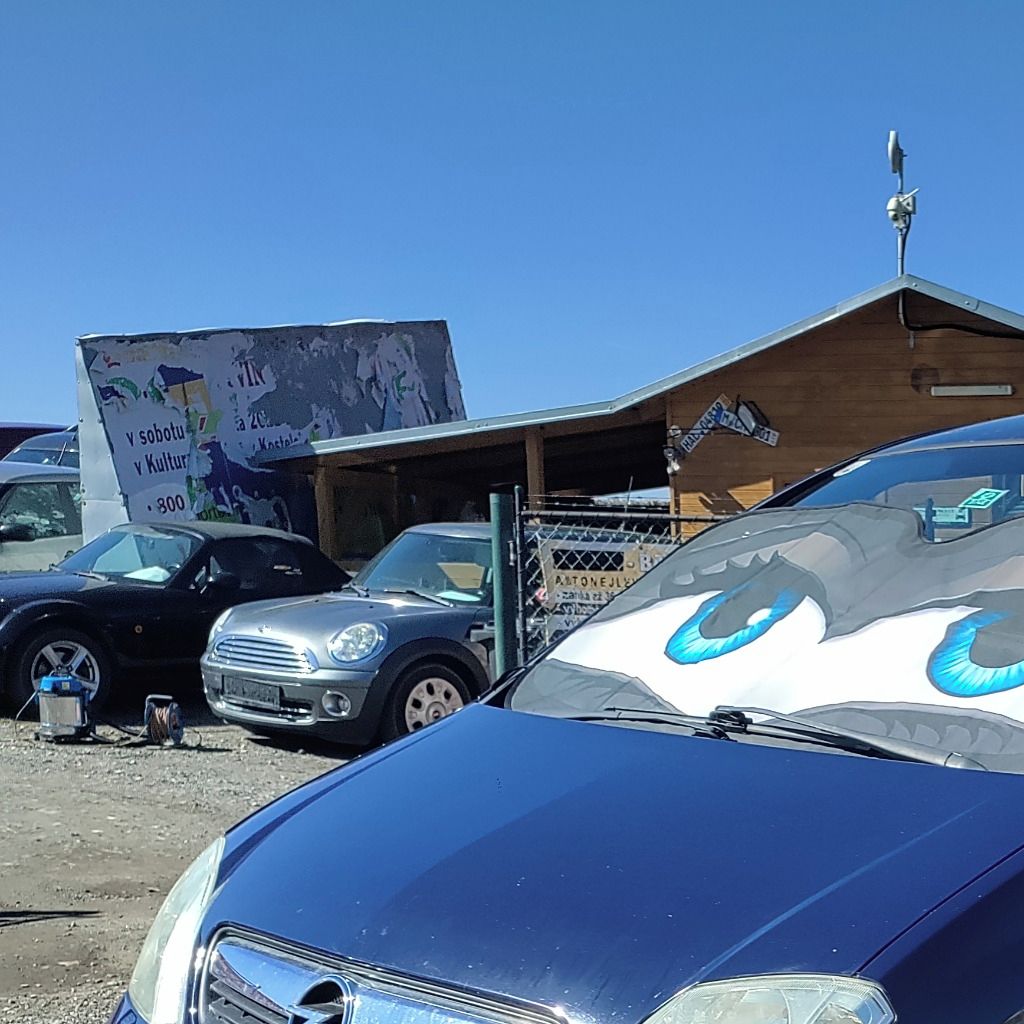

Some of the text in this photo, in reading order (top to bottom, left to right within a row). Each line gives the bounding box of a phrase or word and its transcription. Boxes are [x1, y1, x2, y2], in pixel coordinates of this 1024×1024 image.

[126, 421, 186, 447] v sobotu
[134, 452, 190, 476] v Kultur
